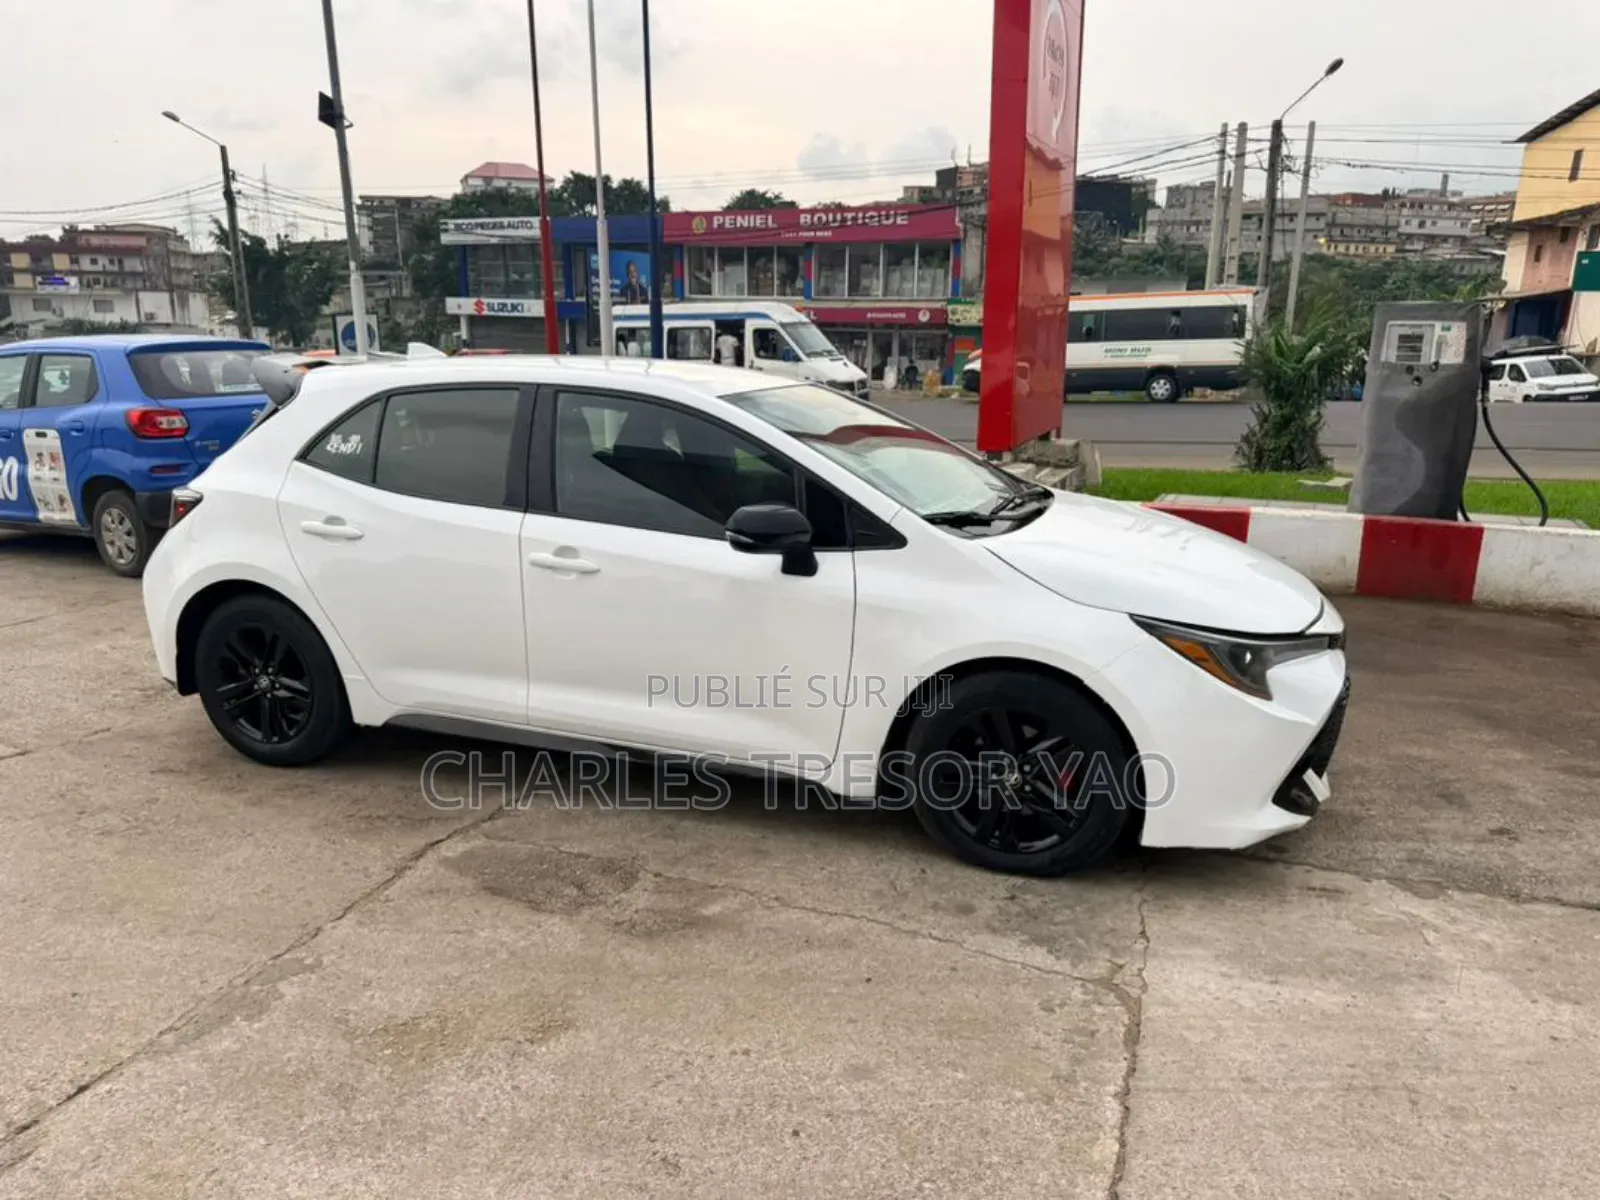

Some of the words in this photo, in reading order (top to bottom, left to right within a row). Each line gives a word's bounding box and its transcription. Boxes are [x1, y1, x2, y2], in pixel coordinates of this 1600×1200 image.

[505, 219, 534, 231] AUTO
[712, 213, 778, 230] PENIEL
[799, 209, 910, 227] BOUTIQUE
[486, 301, 525, 314] SUZUKI
